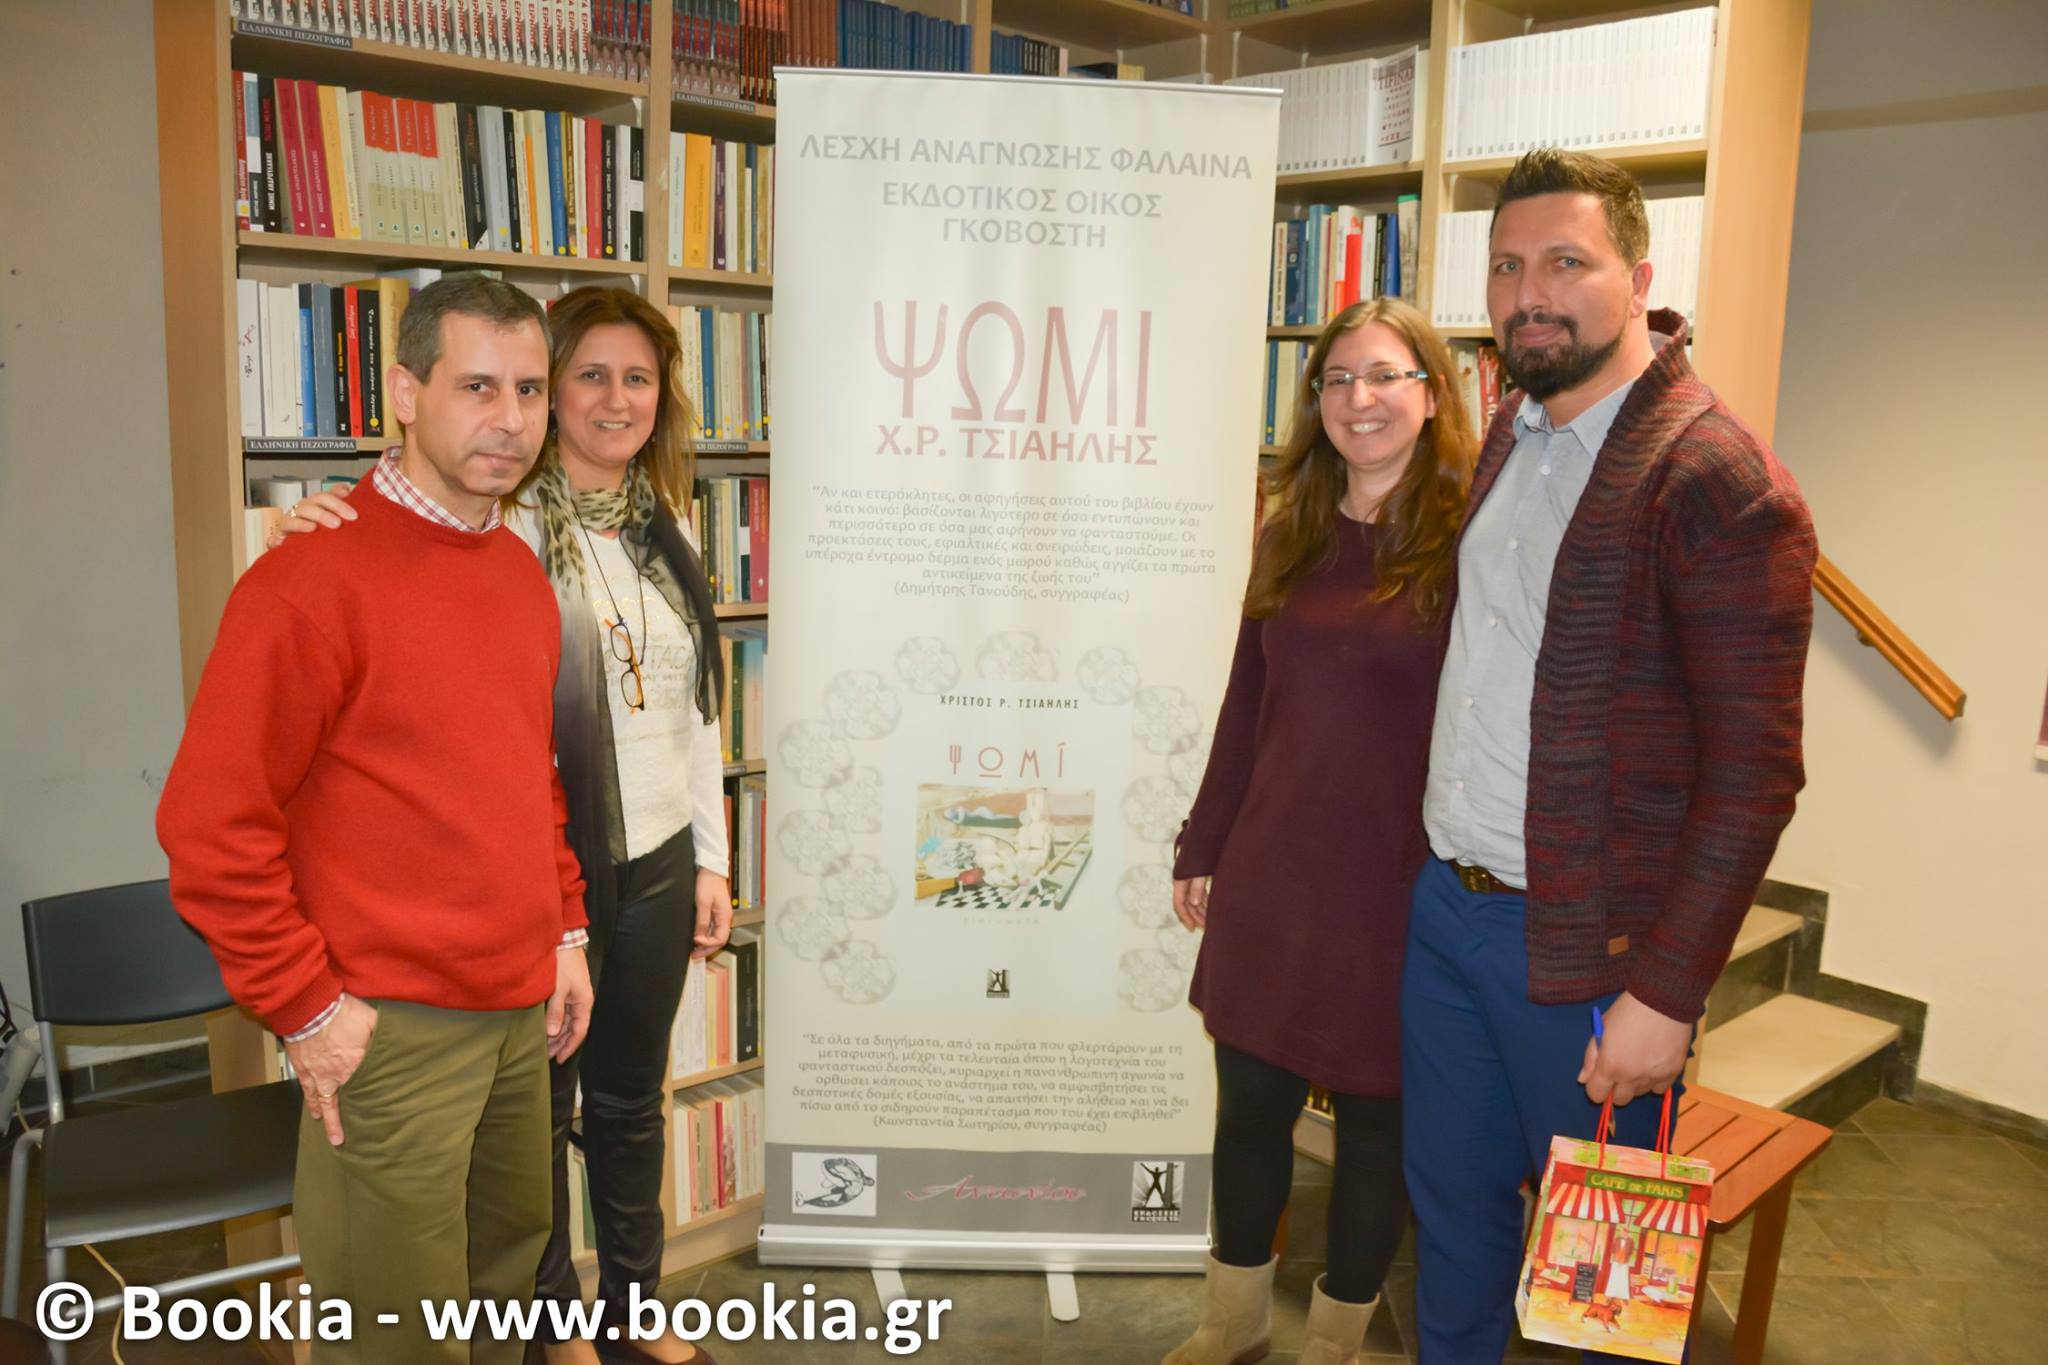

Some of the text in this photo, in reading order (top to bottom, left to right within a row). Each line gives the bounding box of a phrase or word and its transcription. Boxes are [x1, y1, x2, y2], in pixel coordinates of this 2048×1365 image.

[242, 23, 350, 47] ΕΛΛΗΝΙΚΗ ΠΕΖΟΓΡΑΦΙΑ
[800, 134, 1253, 180] ΛΕΣΧΗ ΑΝΑΓΝΩΣΗΣ ΦΑΛΑΙΝΑ
[882, 181, 1161, 218] ΕΚΔΟΤΙΚΟΣ ΟΙΚΟΣ
[942, 218, 1106, 249] ΓΚΟΒΟΣΤΗ
[873, 300, 1152, 428] ΨΩΜΙ
[250, 439, 355, 449] ΕΛΛΗΝΙΚΗ ΠΕΖΟΓΡΑΦΙΑ
[875, 424, 1158, 466] Χ.Ρ. ΤΣΙΑΗΛΗΣ
[841, 489, 863, 498] και
[866, 488, 955, 504] ετερόκλητες,
[959, 494, 971, 502] οι
[974, 492, 1046, 508] αφηγήσεις
[1049, 495, 1090, 506] αυτού
[1095, 499, 1118, 507] του
[1122, 497, 1172, 511] βιβλίου
[1175, 499, 1214, 513] έχουν
[805, 548, 1216, 575] υπέροχα έντρομο δέρμα ενός μωρού καθώς αγγίζει τα πρώτα
[894, 582, 1130, 603] (Δημήτρης Τανούδης, συγγραφέας)
[940, 695, 1080, 709] ΧΡΙΣΤΟΣ Ρ. ΤΣΙΑΗΛΗΣ
[827, 1035, 851, 1045] όλα
[854, 1038, 869, 1046] τα
[873, 1036, 943, 1050] διηγήματα,
[947, 1038, 971, 1048] από
[976, 1041, 990, 1049] τα
[994, 1039, 1036, 1052] πρώτα
[1040, 1042, 1064, 1050] που
[1067, 1041, 1147, 1054] φλερτάρουν
[1150, 1045, 1163, 1055] με
[1169, 1046, 1182, 1056] τη
[1646, 1183, 1685, 1199] PARIS
